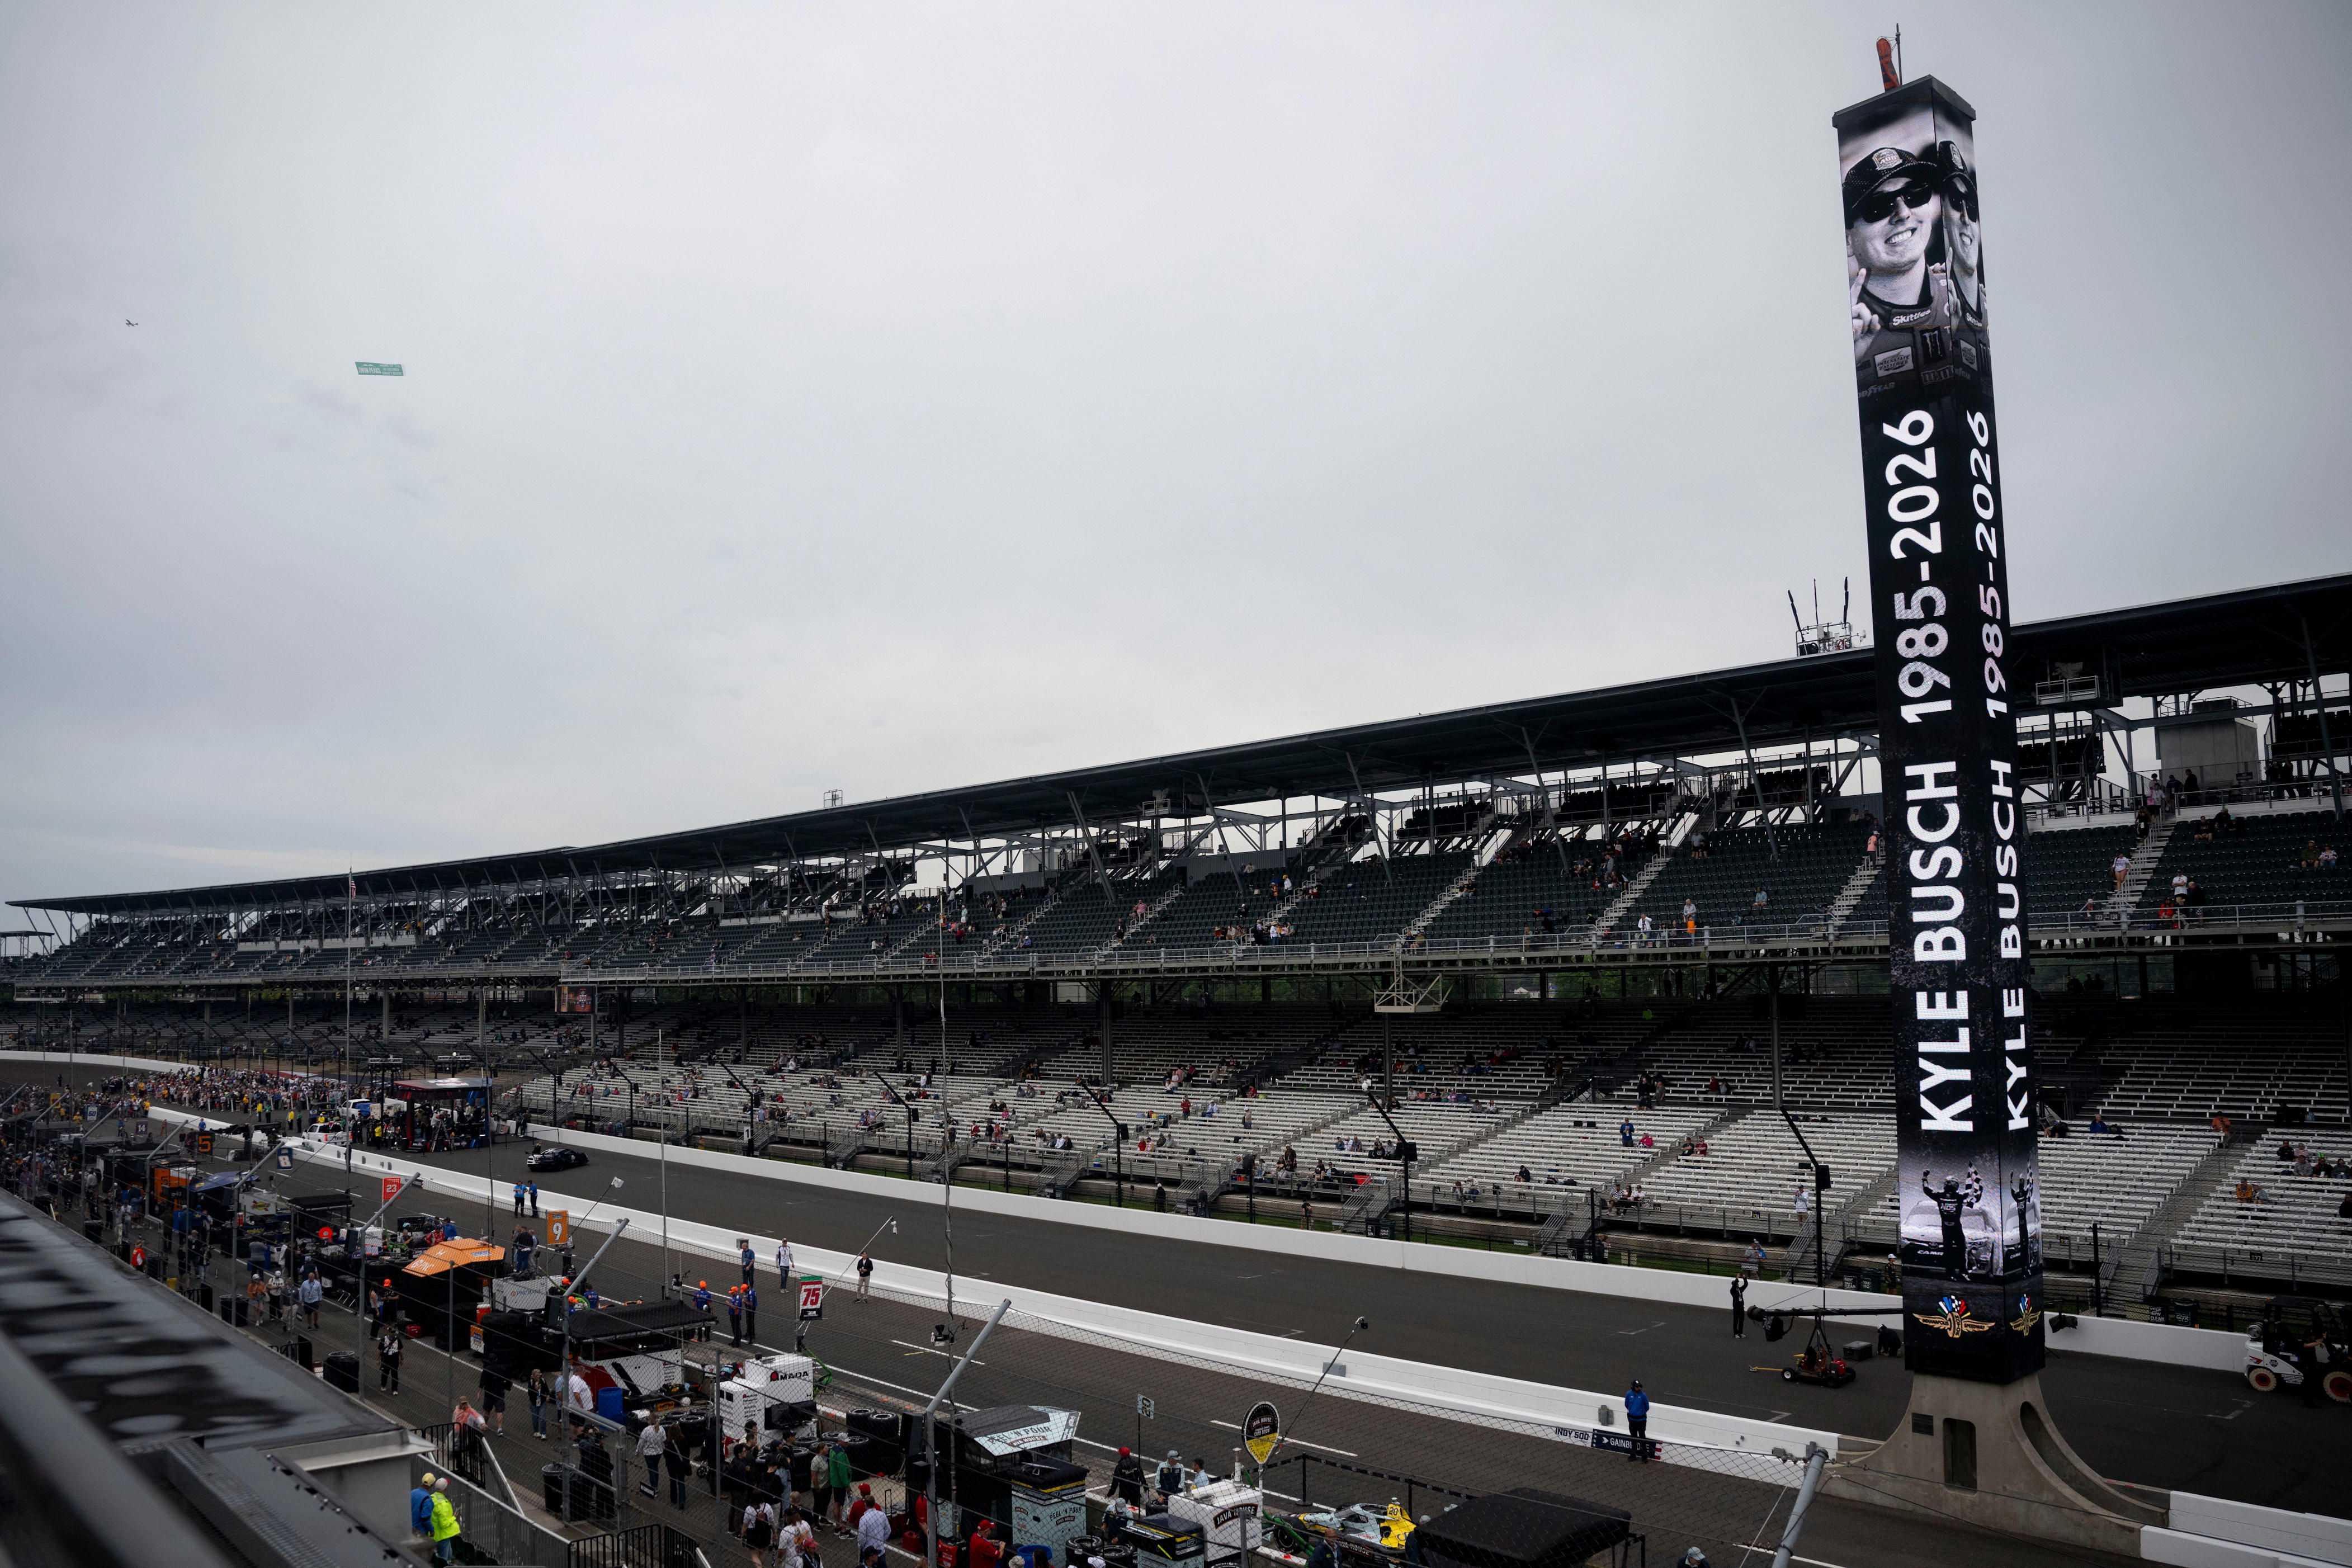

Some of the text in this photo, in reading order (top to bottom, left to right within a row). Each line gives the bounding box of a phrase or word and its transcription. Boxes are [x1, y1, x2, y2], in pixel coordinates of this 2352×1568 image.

[1893, 309, 1931, 326] Skittles
[1883, 410, 1951, 723] 1985-2026
[1967, 409, 2028, 1130] KYLE BUSCH 1985-2026
[1905, 761, 1966, 961] BUSCH
[1916, 990, 1973, 1131] KYLE
[137, 1124, 145, 1132] 14
[745, 1129, 749, 1138] 1
[197, 1135, 212, 1153] 5
[278, 1155, 291, 1168] 8
[386, 1184, 397, 1193] 23
[552, 1221, 563, 1241] 9
[802, 1288, 821, 1306] 75
[771, 1371, 809, 1382] AMADA
[1141, 1397, 1151, 1418] 20
[1023, 1426, 1052, 1435] POUR
[1555, 1428, 1589, 1441] INDY 500
[1610, 1438, 1650, 1453] GAINBDE
[1050, 1510, 1061, 1520] PEEL
[1217, 1511, 1232, 1525] JAVA
[1388, 1506, 1399, 1516] 20
